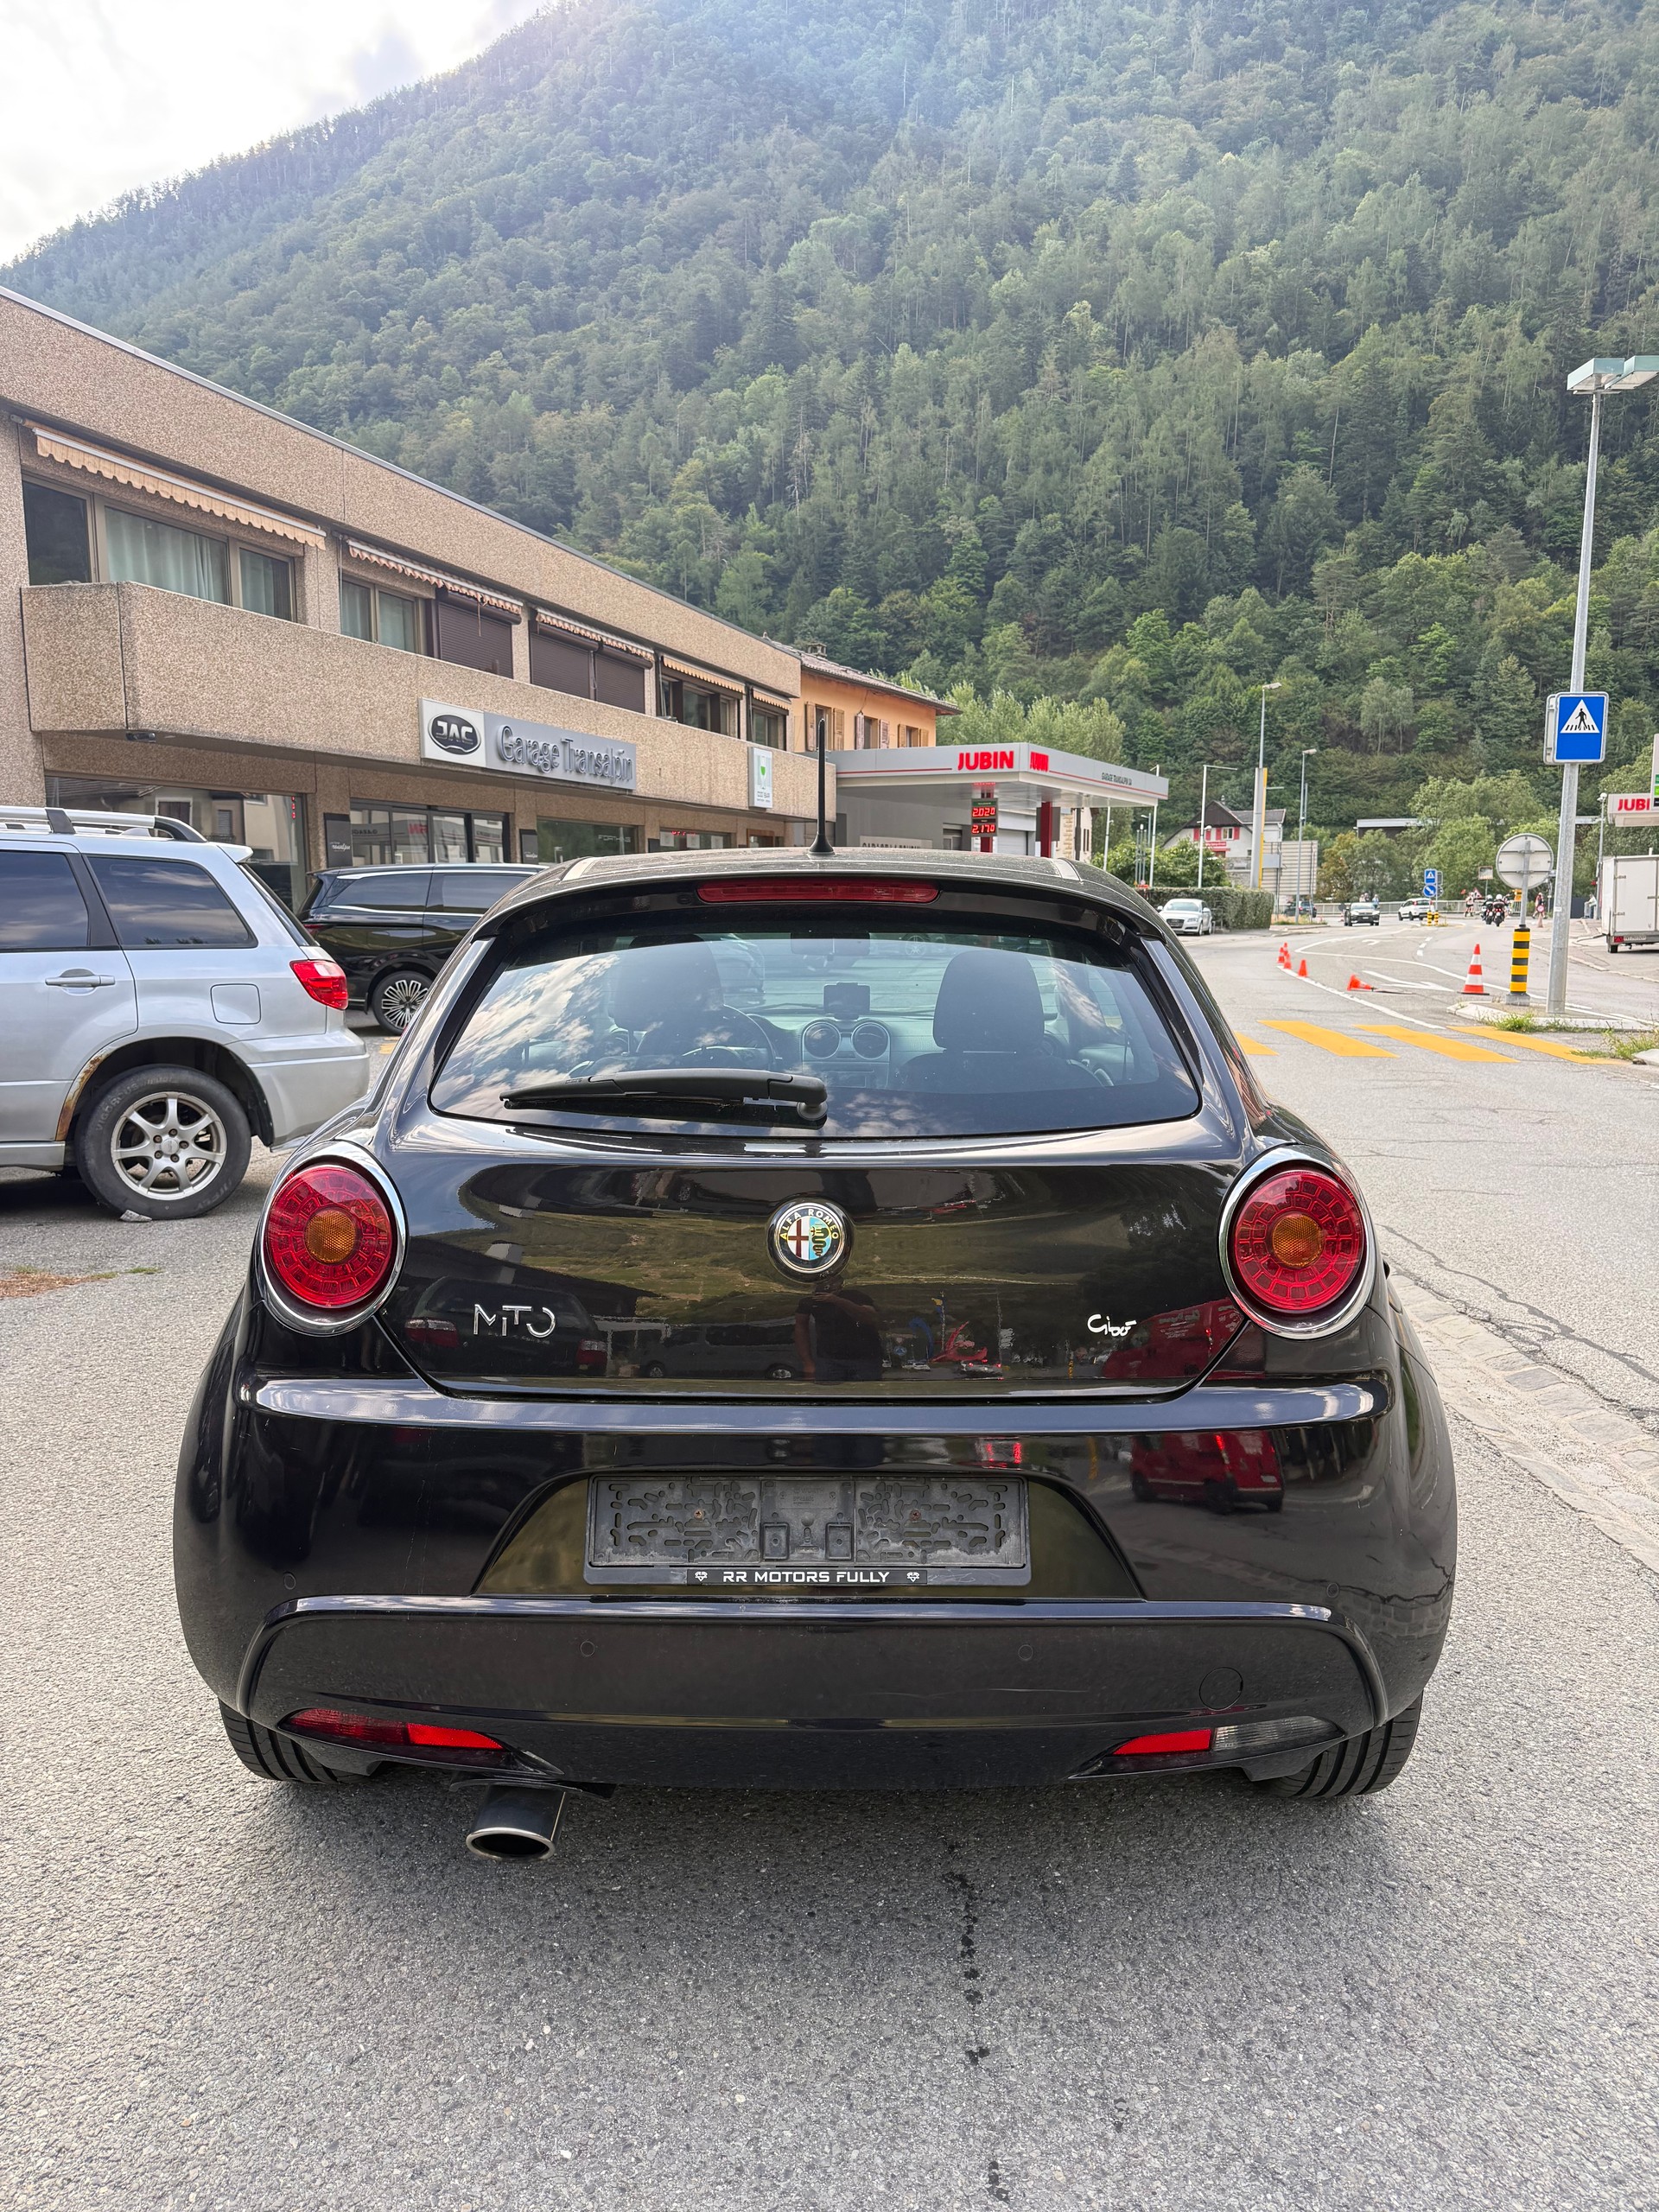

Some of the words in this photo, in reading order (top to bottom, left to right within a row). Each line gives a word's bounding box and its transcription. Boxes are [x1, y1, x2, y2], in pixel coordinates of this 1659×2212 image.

[435, 720, 474, 745] JAC
[496, 725, 560, 773] Garage
[561, 738, 634, 784] Transalpin
[957, 750, 1014, 771] JUBIN
[1618, 798, 1650, 811] JUBI
[779, 1211, 802, 1241] ALFA
[807, 1208, 839, 1239] ROMEO
[722, 1571, 747, 1583] RR
[754, 1571, 830, 1583] MOTORS
[836, 1571, 890, 1583] FULLY
